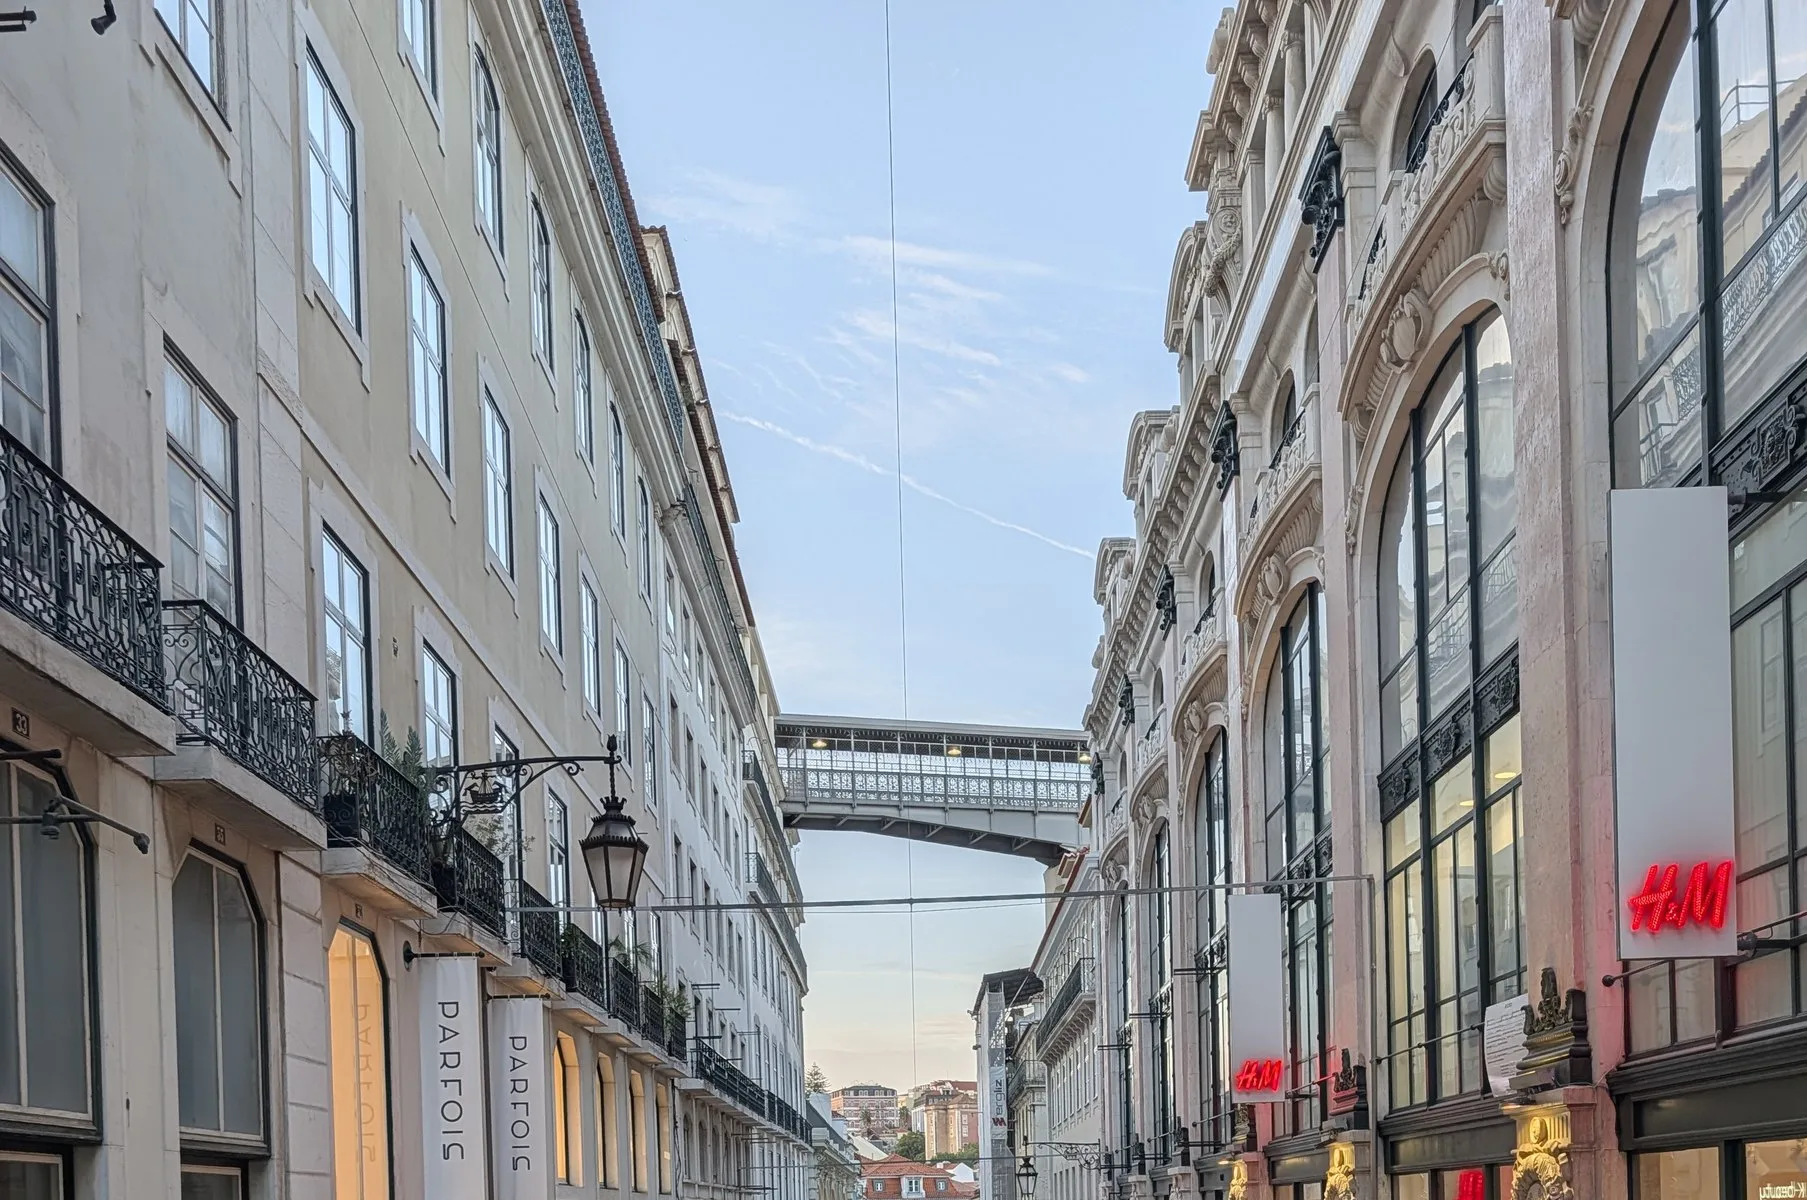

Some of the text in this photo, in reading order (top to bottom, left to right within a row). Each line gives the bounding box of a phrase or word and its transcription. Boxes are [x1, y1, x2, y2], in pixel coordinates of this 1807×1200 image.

[1627, 862, 1732, 932] H&M
[438, 1001, 464, 1161] PARFOIS
[509, 1036, 531, 1171] PARFOIS
